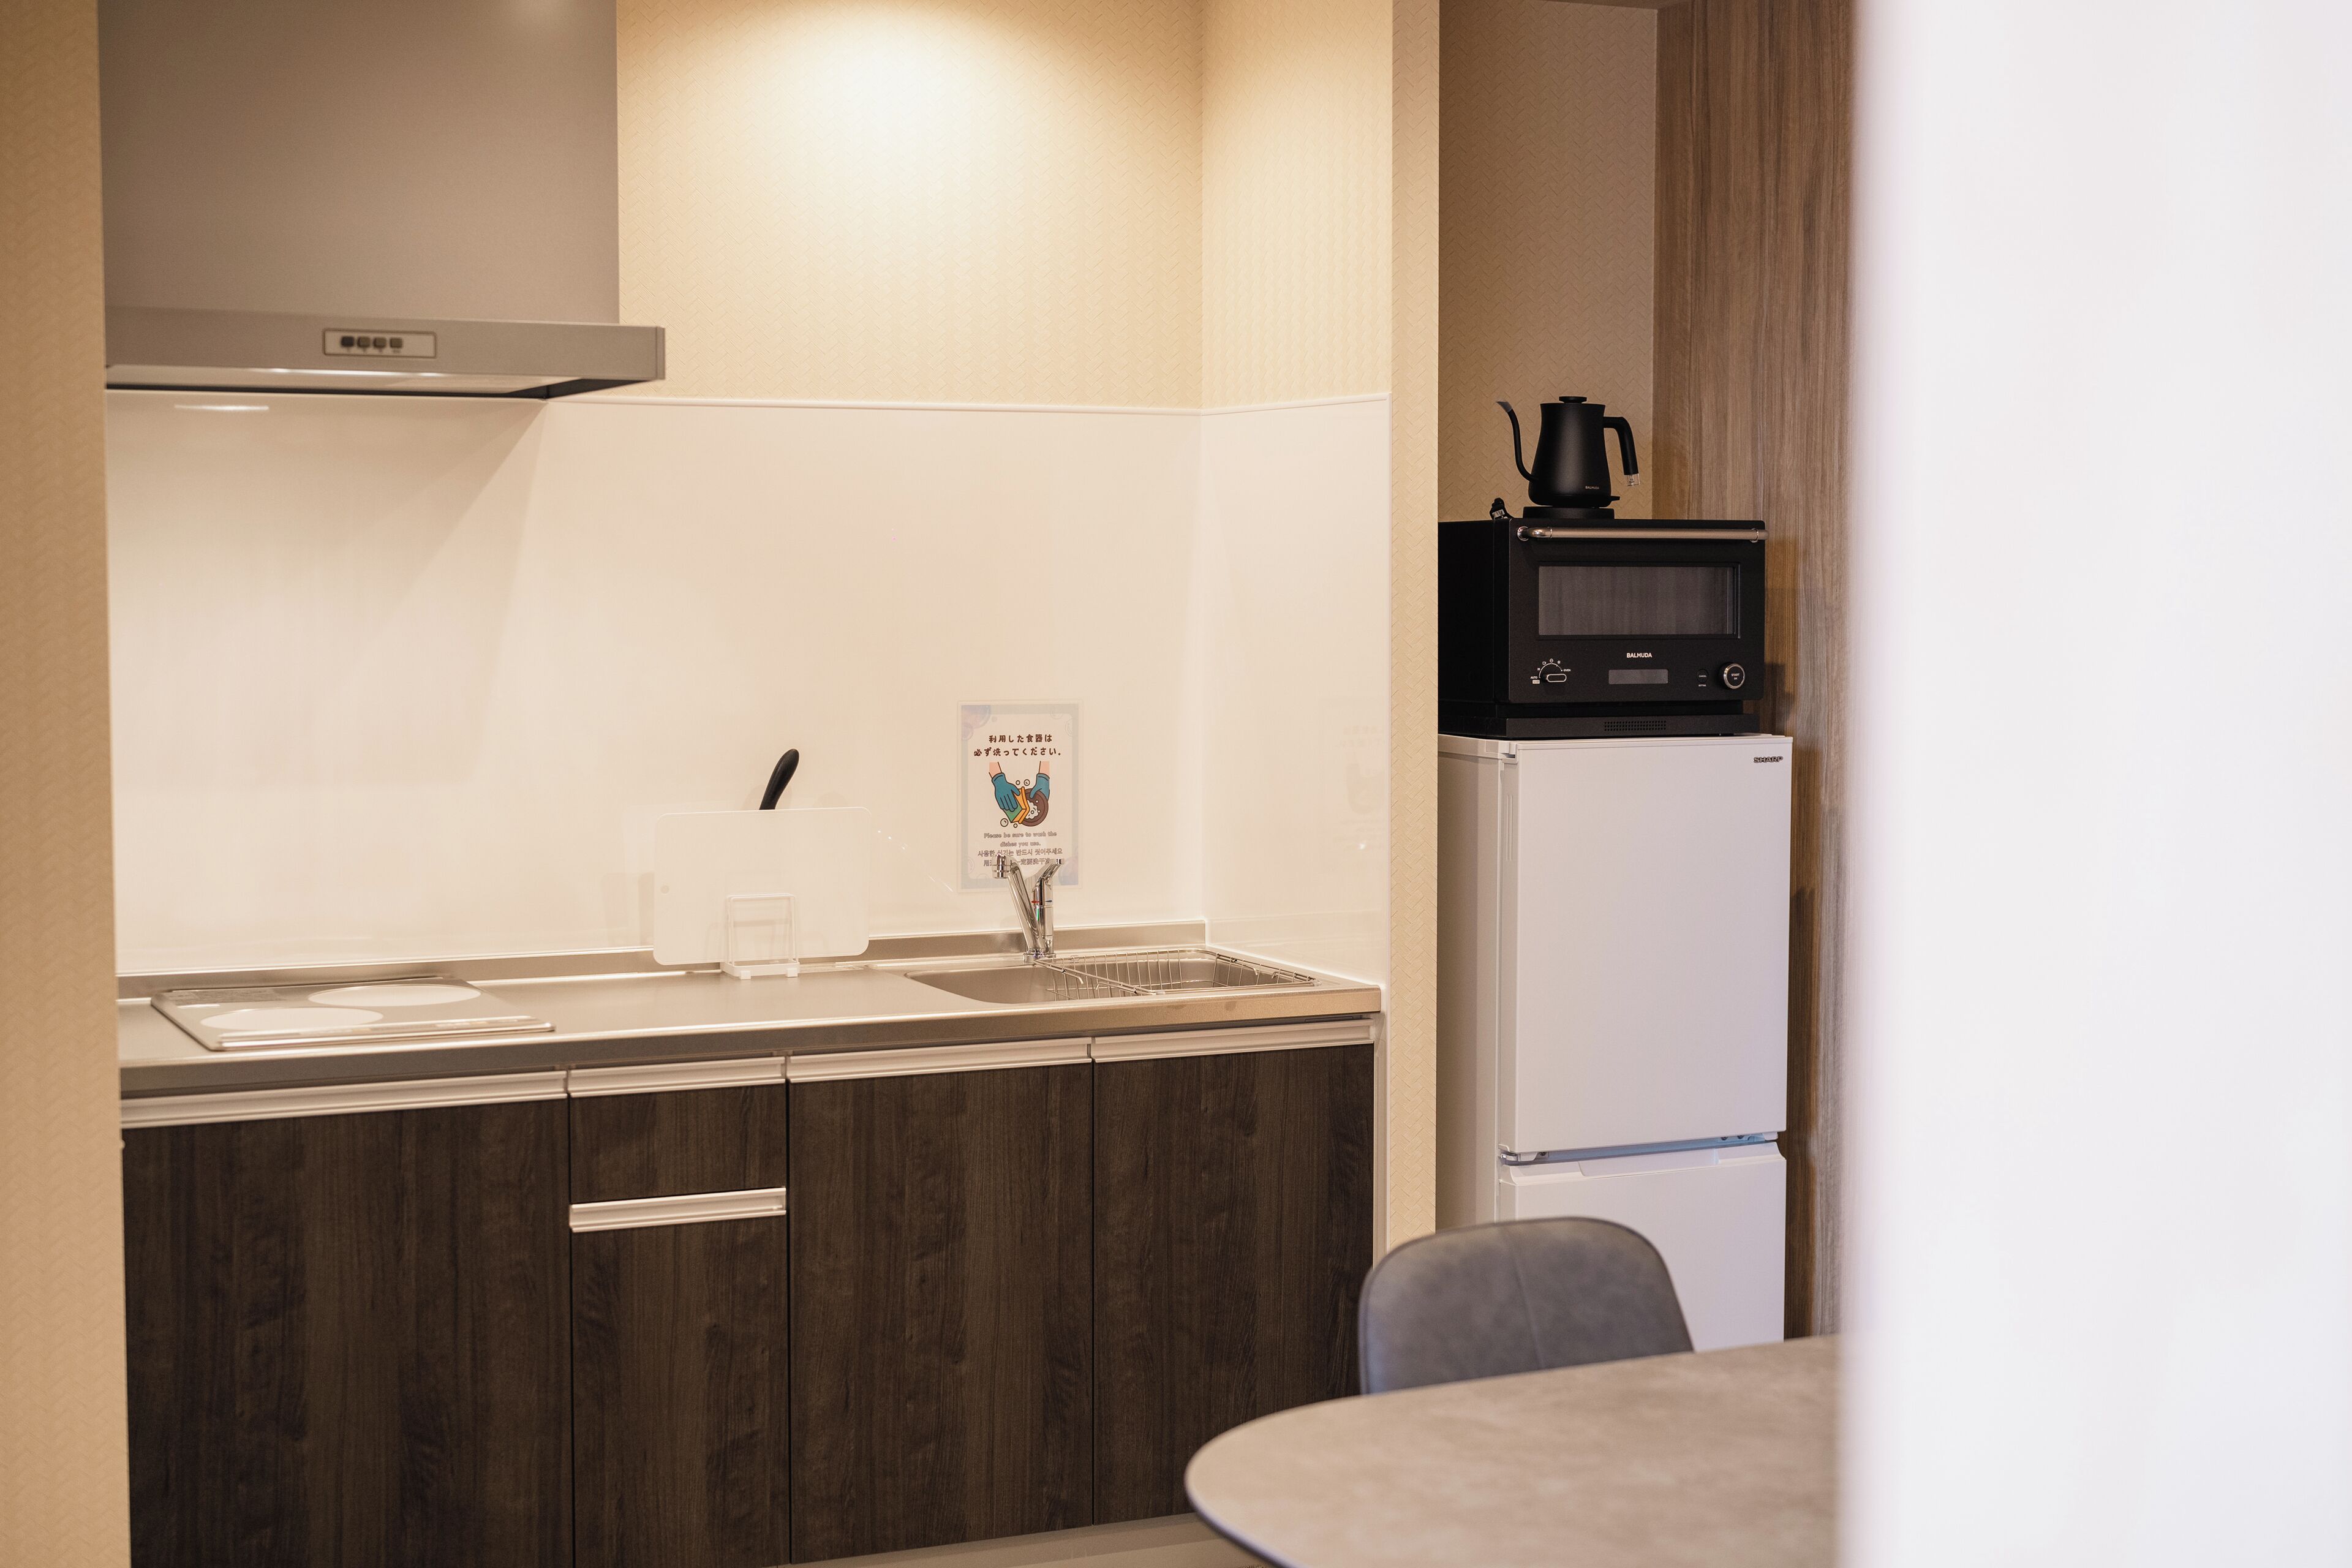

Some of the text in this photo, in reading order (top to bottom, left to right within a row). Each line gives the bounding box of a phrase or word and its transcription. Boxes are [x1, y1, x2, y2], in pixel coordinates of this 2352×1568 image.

[989, 734, 1052, 743] 利用した食器は
[973, 747, 1061, 757] 必ず洗ってください。
